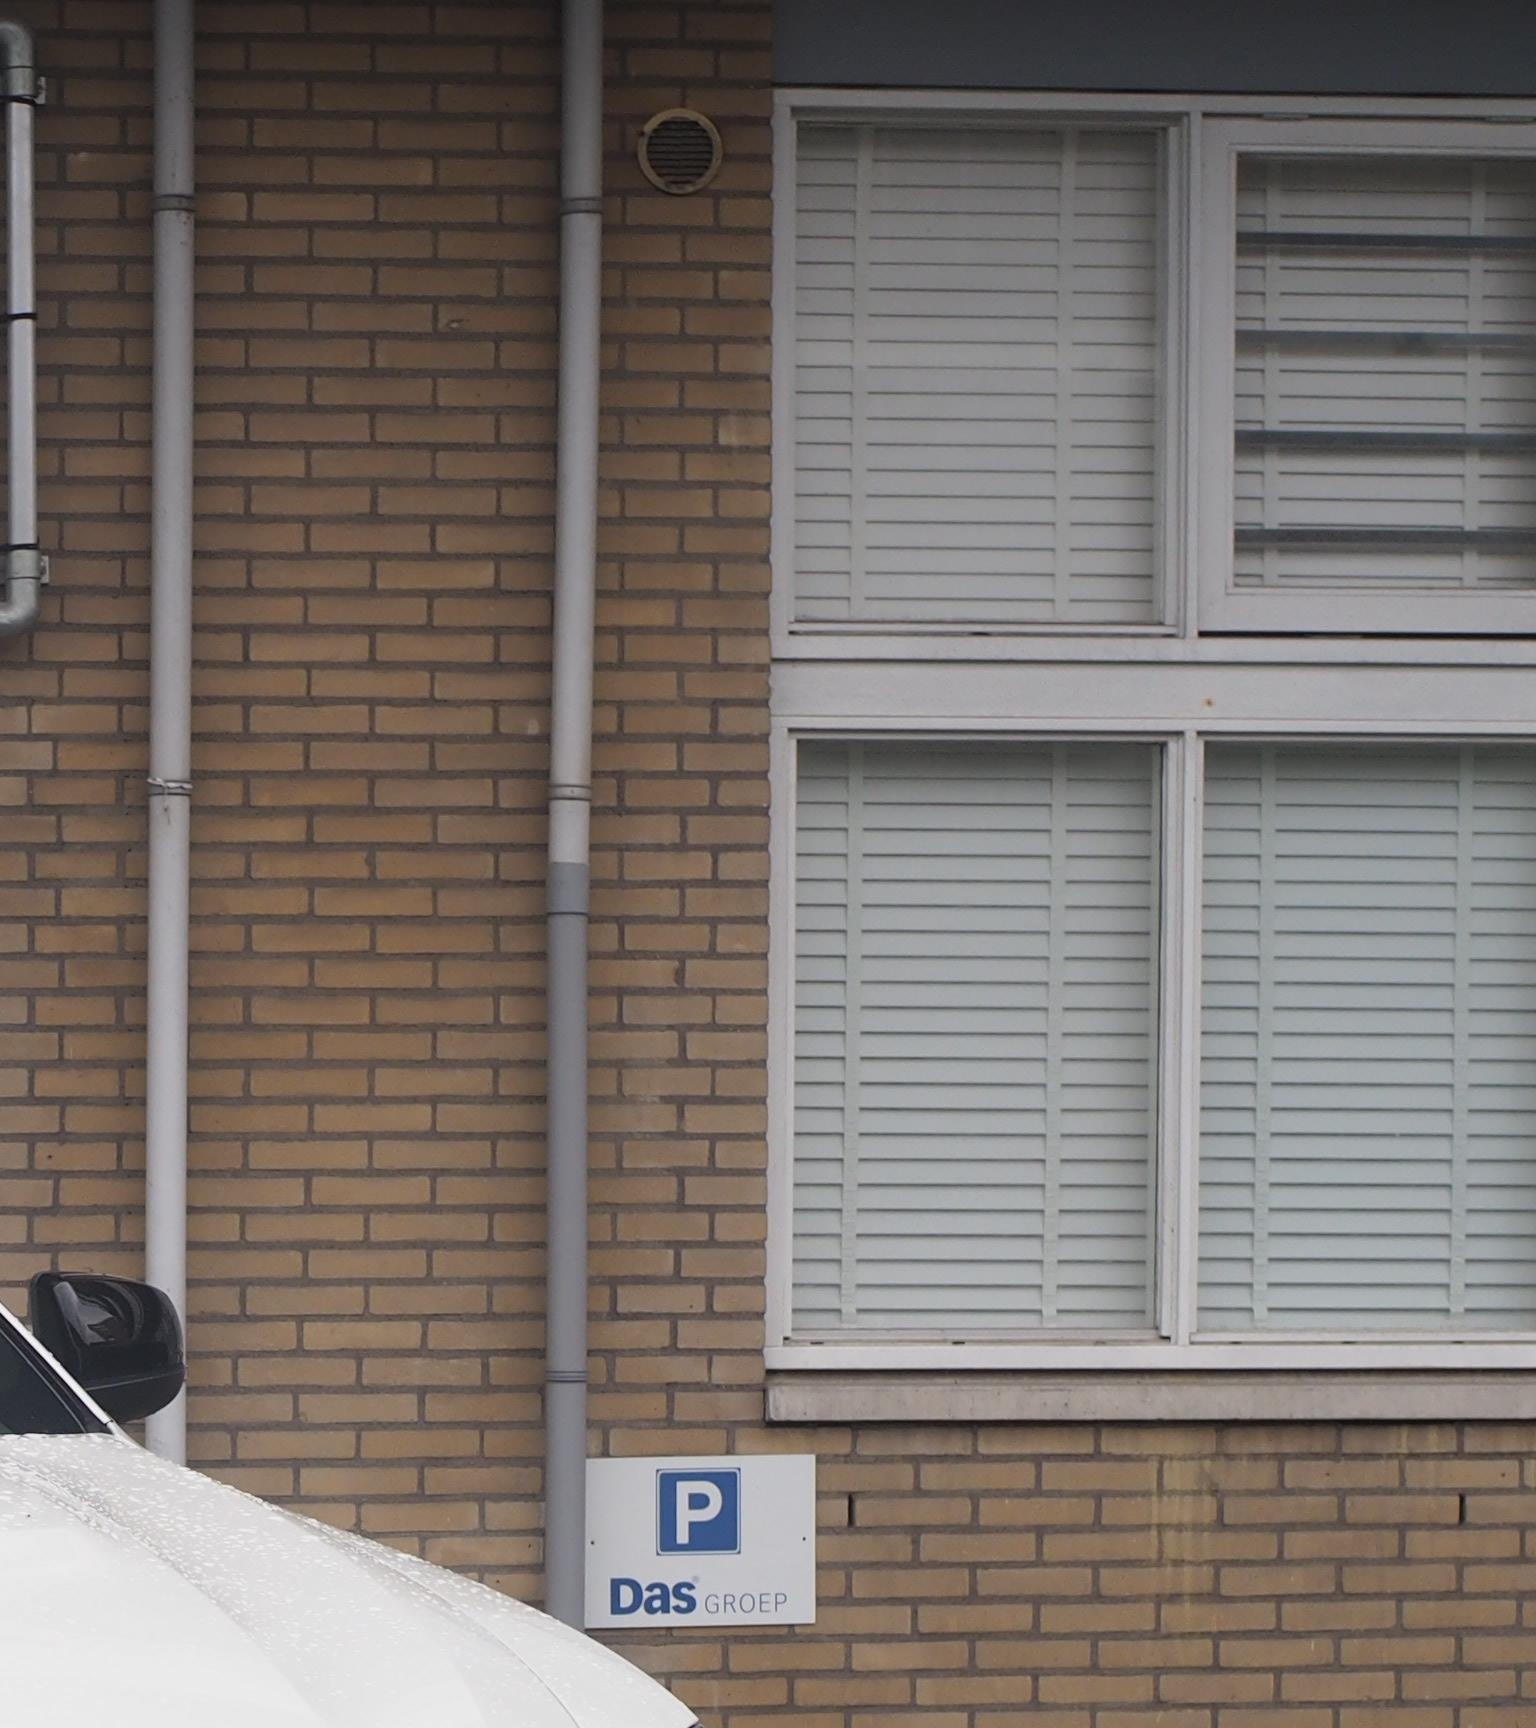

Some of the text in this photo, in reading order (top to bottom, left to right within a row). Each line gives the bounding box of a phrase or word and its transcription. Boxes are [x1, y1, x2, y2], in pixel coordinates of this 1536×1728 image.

[675, 1480, 723, 1545] P
[609, 1577, 788, 1616] Das GROEP
